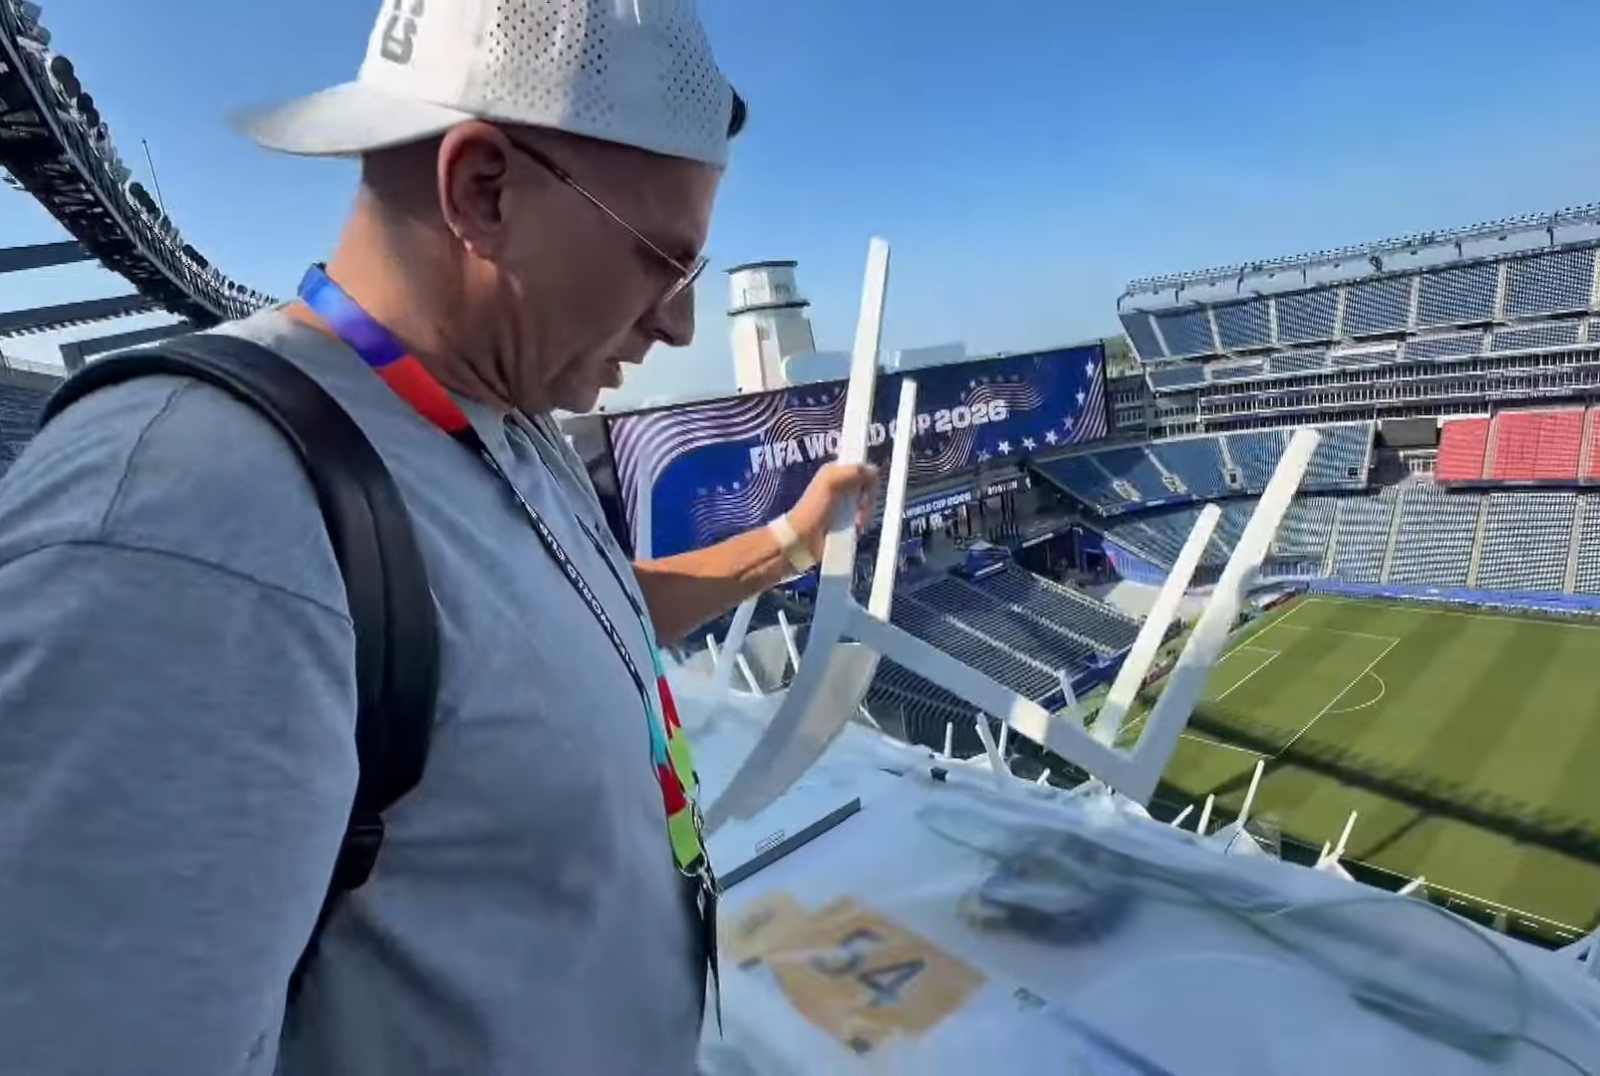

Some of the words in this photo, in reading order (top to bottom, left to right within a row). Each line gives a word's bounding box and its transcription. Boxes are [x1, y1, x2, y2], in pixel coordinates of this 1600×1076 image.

[750, 439, 803, 474] FIFA
[804, 422, 886, 460] WOD
[934, 399, 1007, 433] 2026
[539, 522, 566, 562] CUP
[566, 563, 612, 634] WORLD
